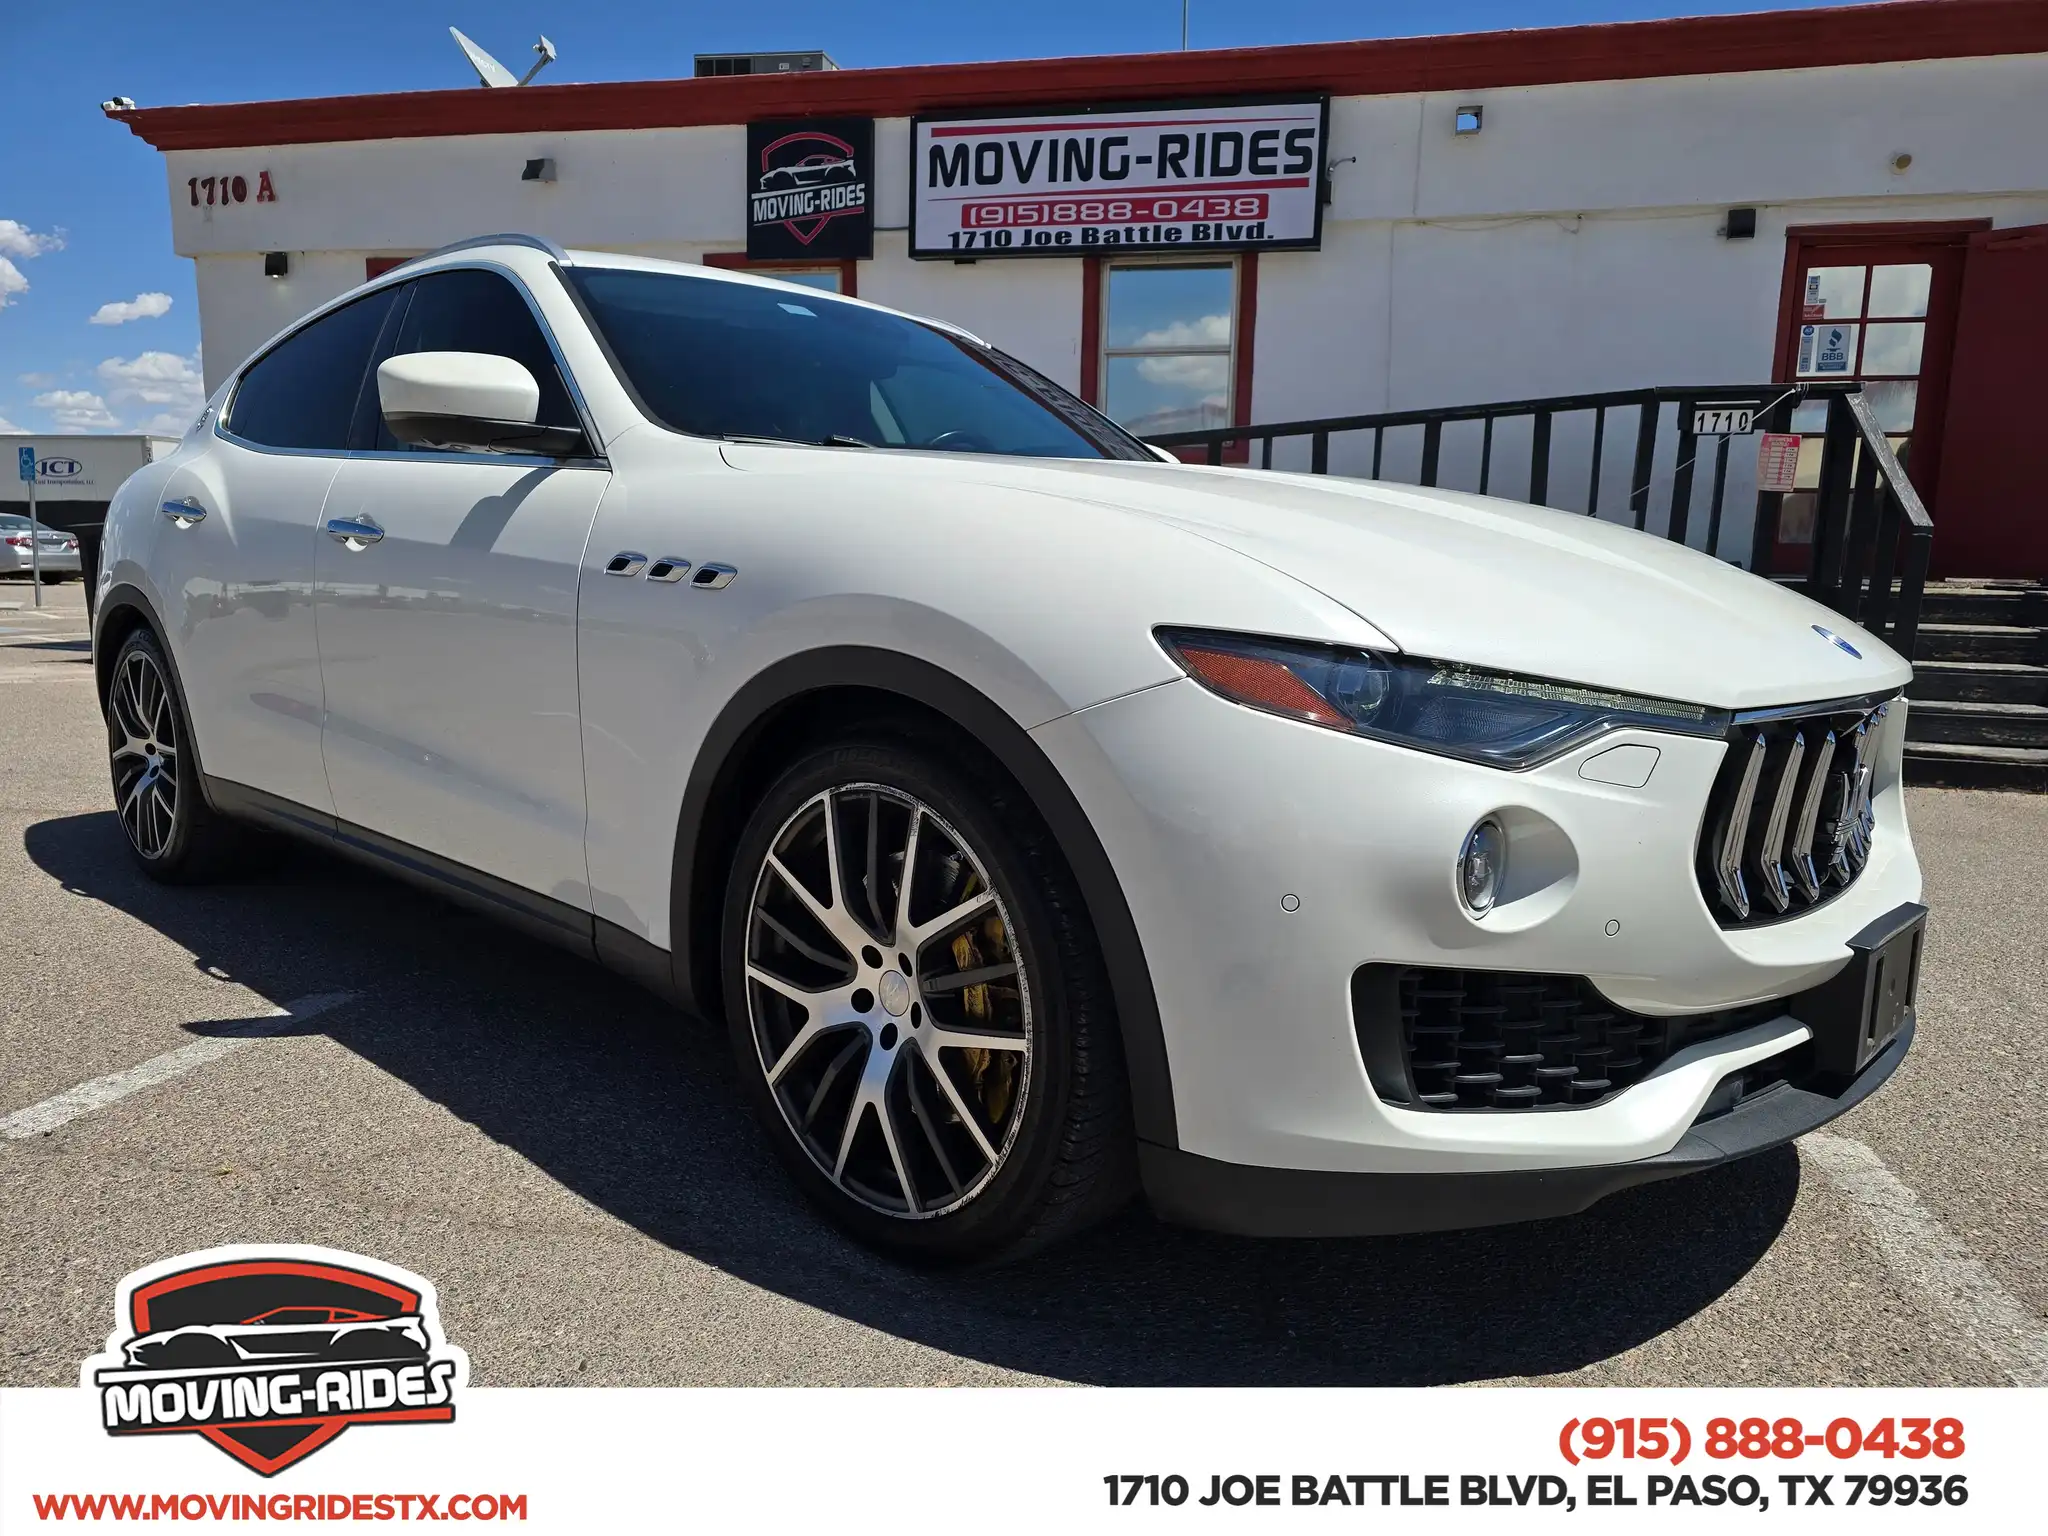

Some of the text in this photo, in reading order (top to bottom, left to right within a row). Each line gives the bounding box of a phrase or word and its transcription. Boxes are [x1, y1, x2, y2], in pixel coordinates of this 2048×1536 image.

[929, 128, 1315, 188] MOVING-RIDES
[187, 170, 276, 207] 1710 A
[753, 183, 865, 222] MOVING-RIDES
[969, 198, 1260, 225] (915)888-0438
[948, 221, 1275, 249] 1710 Joe Battle Blvd.
[1821, 352, 1844, 361] BBB
[1697, 411, 1749, 433] 1710
